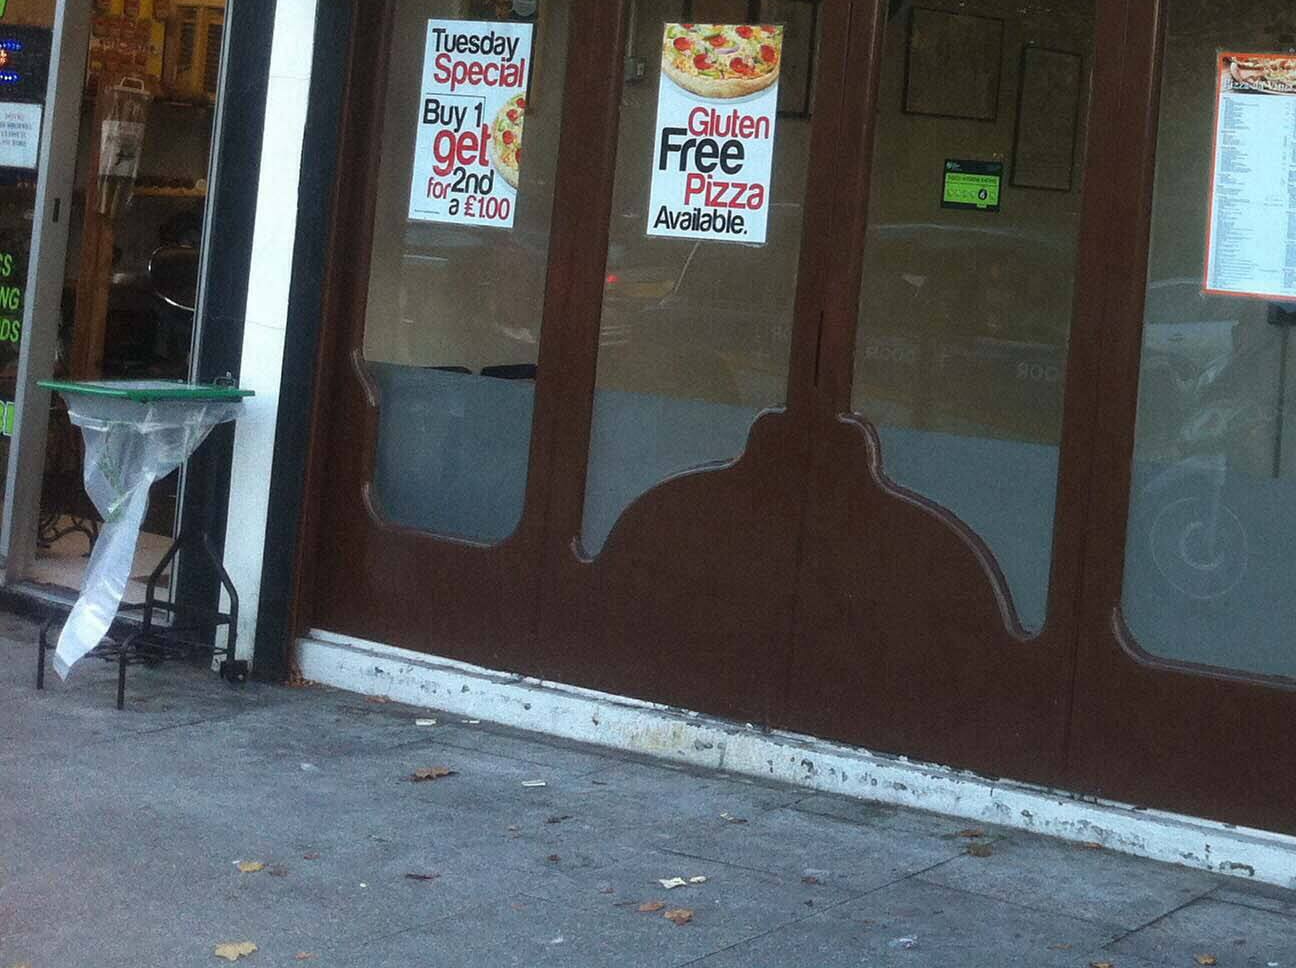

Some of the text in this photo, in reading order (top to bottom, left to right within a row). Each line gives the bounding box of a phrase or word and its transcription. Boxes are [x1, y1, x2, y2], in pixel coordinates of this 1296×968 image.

[432, 28, 520, 62] Tuesday
[433, 53, 526, 91] Special
[423, 98, 483, 133] Buy 1
[687, 106, 770, 139] Gluten
[432, 123, 491, 177] get
[659, 126, 745, 174] Free
[427, 177, 451, 199] for
[451, 166, 495, 195] 2nd
[684, 173, 764, 210] Pizza
[449, 198, 460, 216] a
[653, 205, 748, 235] Available.
